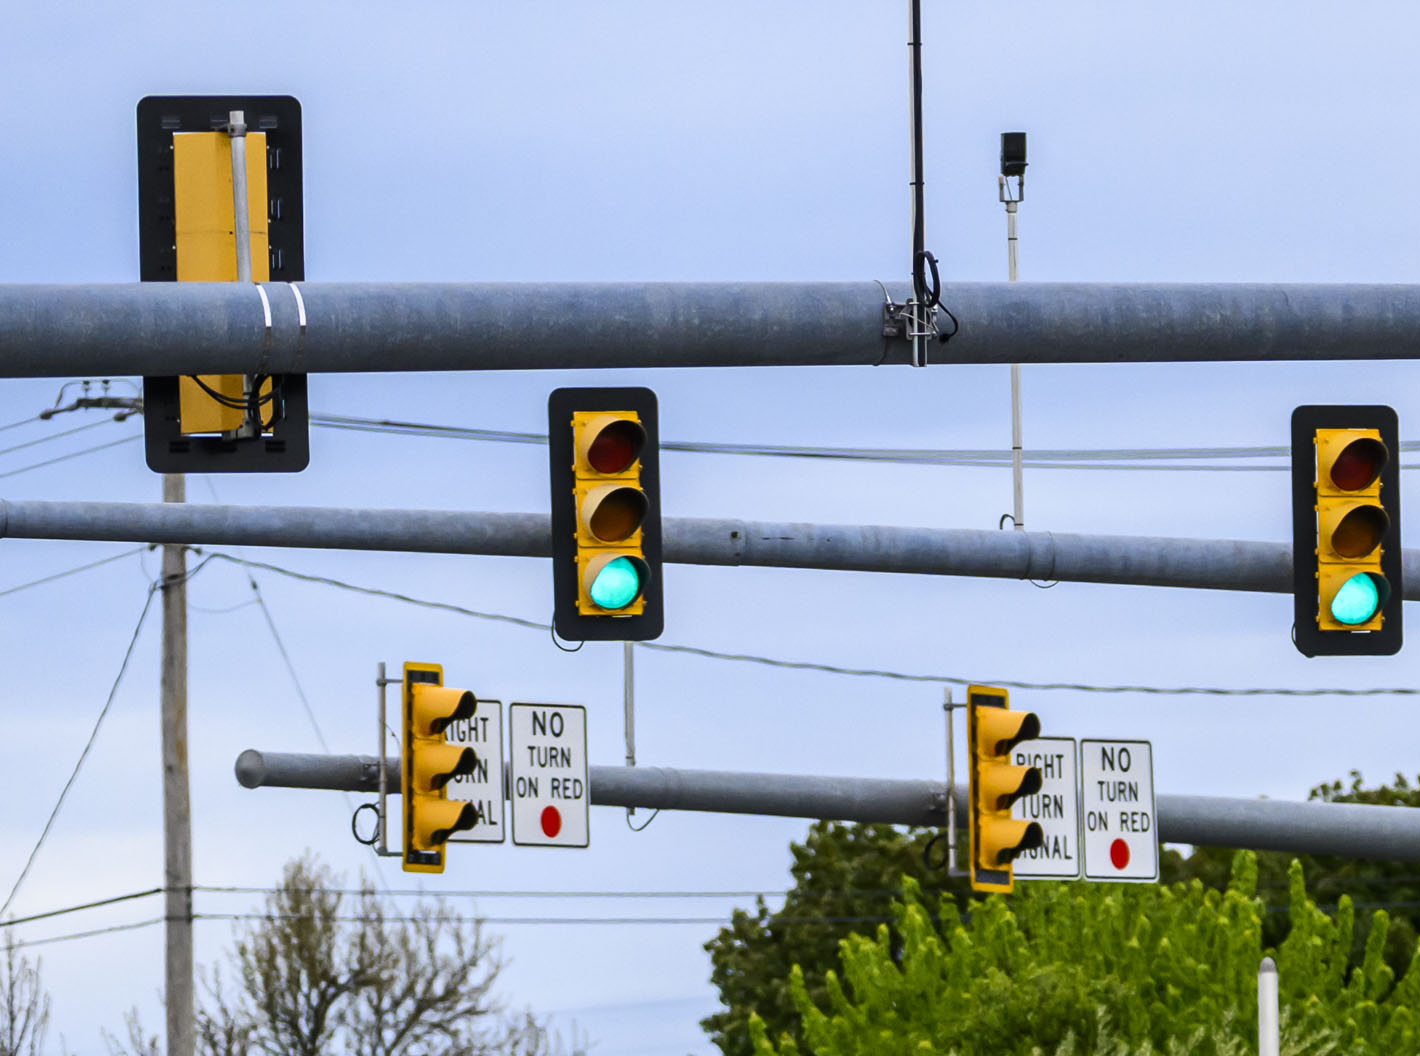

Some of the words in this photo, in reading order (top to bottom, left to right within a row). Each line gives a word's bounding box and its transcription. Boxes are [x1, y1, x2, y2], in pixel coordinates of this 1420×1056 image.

[444, 717, 489, 743] IGHT
[531, 711, 564, 737] NO
[527, 745, 571, 768] TURN
[1101, 747, 1131, 772] NO
[516, 776, 539, 798] ON
[551, 777, 583, 800] RED
[1097, 781, 1138, 802] TURN
[1087, 811, 1108, 831] ON
[1120, 811, 1150, 833] RED
[1015, 834, 1073, 860] NAL
